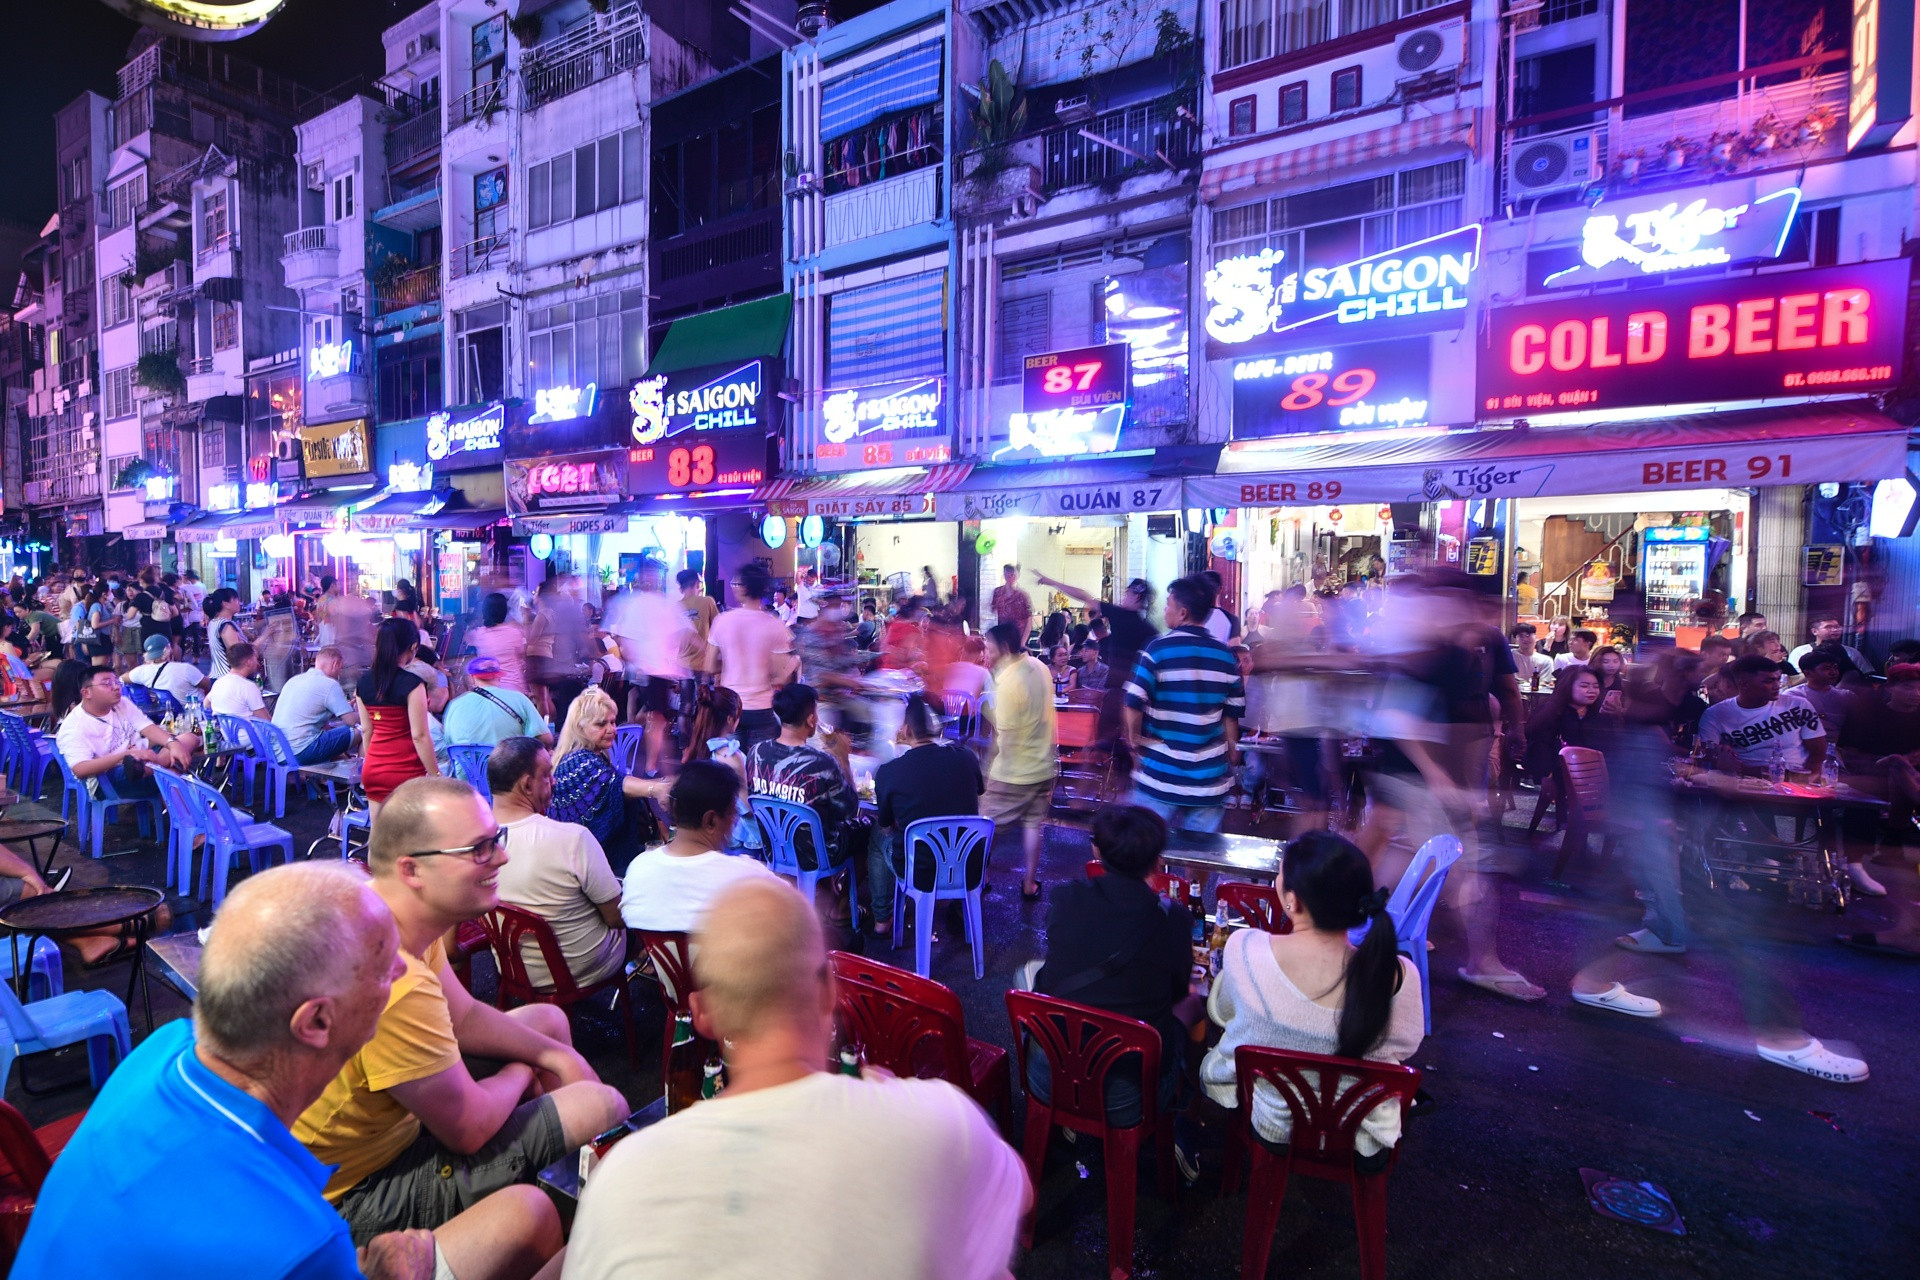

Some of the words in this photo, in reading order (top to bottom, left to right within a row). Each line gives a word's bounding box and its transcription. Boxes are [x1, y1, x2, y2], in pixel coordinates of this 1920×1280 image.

[1304, 252, 1472, 300] SAIGON
[1338, 286, 1468, 324] CHILL
[1509, 310, 1668, 376] COLD
[1688, 288, 1872, 359] BEER
[1026, 355, 1058, 369] BEER
[1044, 362, 1102, 394] 87
[1280, 368, 1376, 410] 89
[677, 382, 756, 414] SAIGON
[866, 394, 936, 418] SAIGON
[455, 419, 500, 440] SAIGON
[694, 408, 756, 430] CHILL
[882, 414, 938, 431] CHILL
[465, 436, 500, 451] CHILL
[864, 444, 892, 464] 85
[630, 449, 654, 462] BEER
[668, 446, 714, 486] 83
[1452, 466, 1522, 494] Tiger
[1642, 459, 1726, 485] BEER
[1747, 455, 1791, 479] 91
[1060, 489, 1120, 511] QUÁN
[1133, 489, 1162, 507] 87
[1241, 484, 1296, 502] BEER
[1307, 481, 1342, 500] 89
[892, 501, 912, 513] 85
[982, 492, 1022, 515] Tiger
[570, 520, 600, 532] HOPES
[604, 520, 614, 530] 81
[769, 781, 805, 804] HABITS
[1808, 1068, 1850, 1081] crocs
